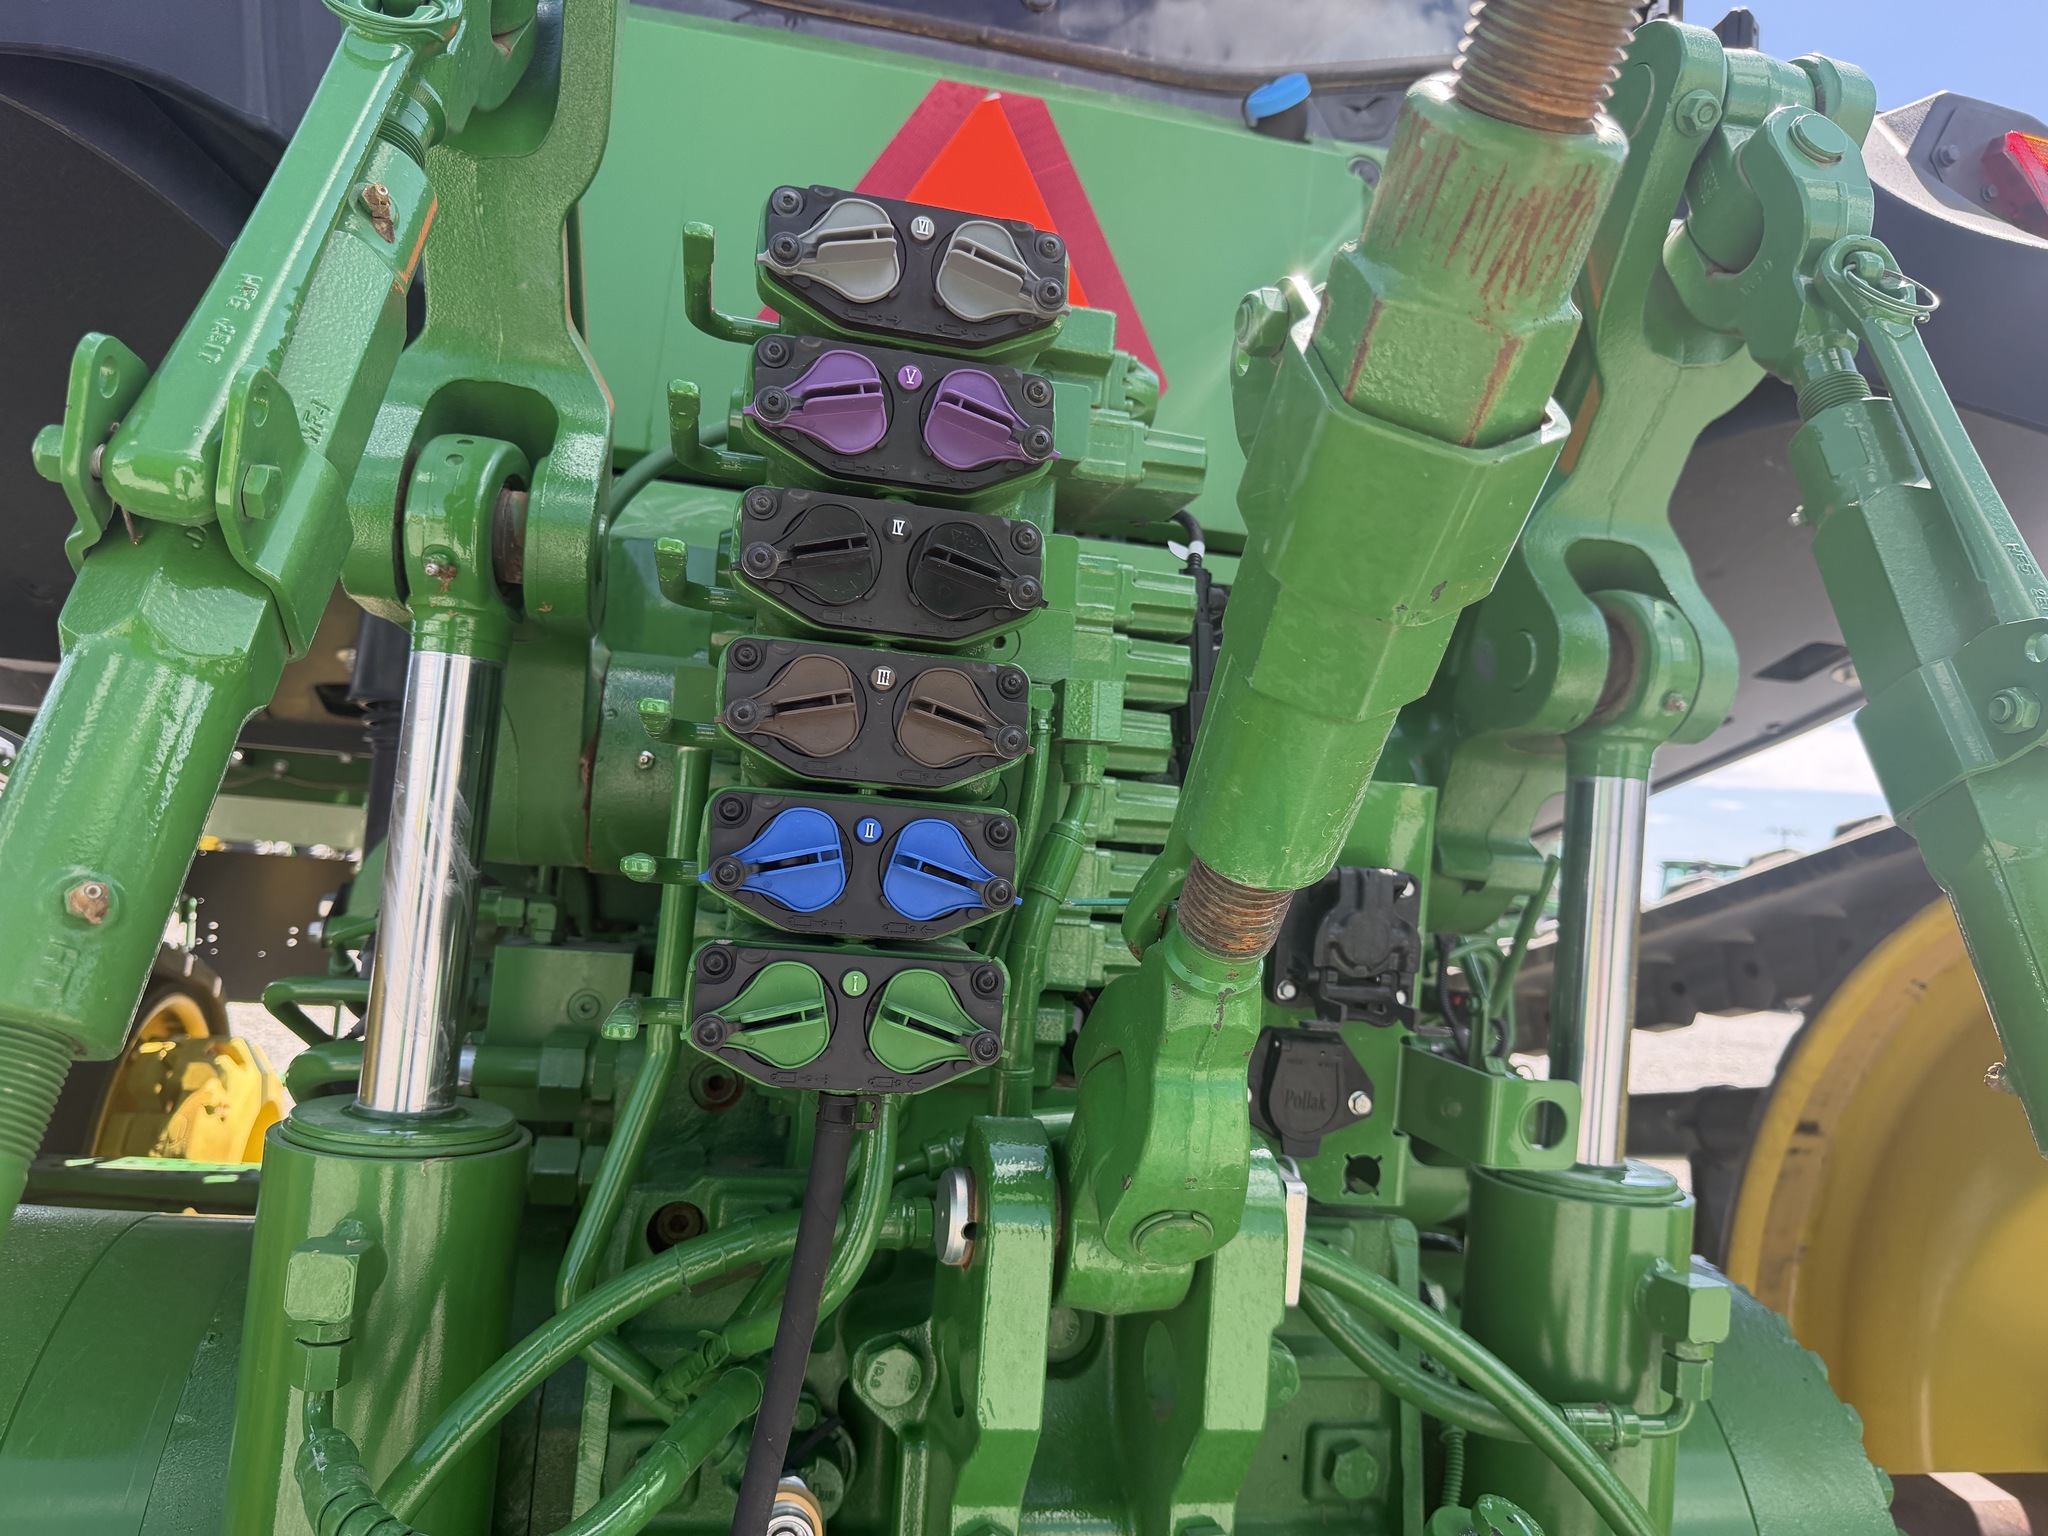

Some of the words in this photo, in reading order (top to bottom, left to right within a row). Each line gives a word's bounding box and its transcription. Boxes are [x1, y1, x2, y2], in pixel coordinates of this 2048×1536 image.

[916, 218, 929, 235] VI
[904, 368, 918, 384] V
[892, 519, 905, 536] IV
[876, 669, 891, 686] III
[864, 822, 875, 838] II
[853, 976, 859, 991] I
[1283, 1087, 1327, 1112] Pollak
